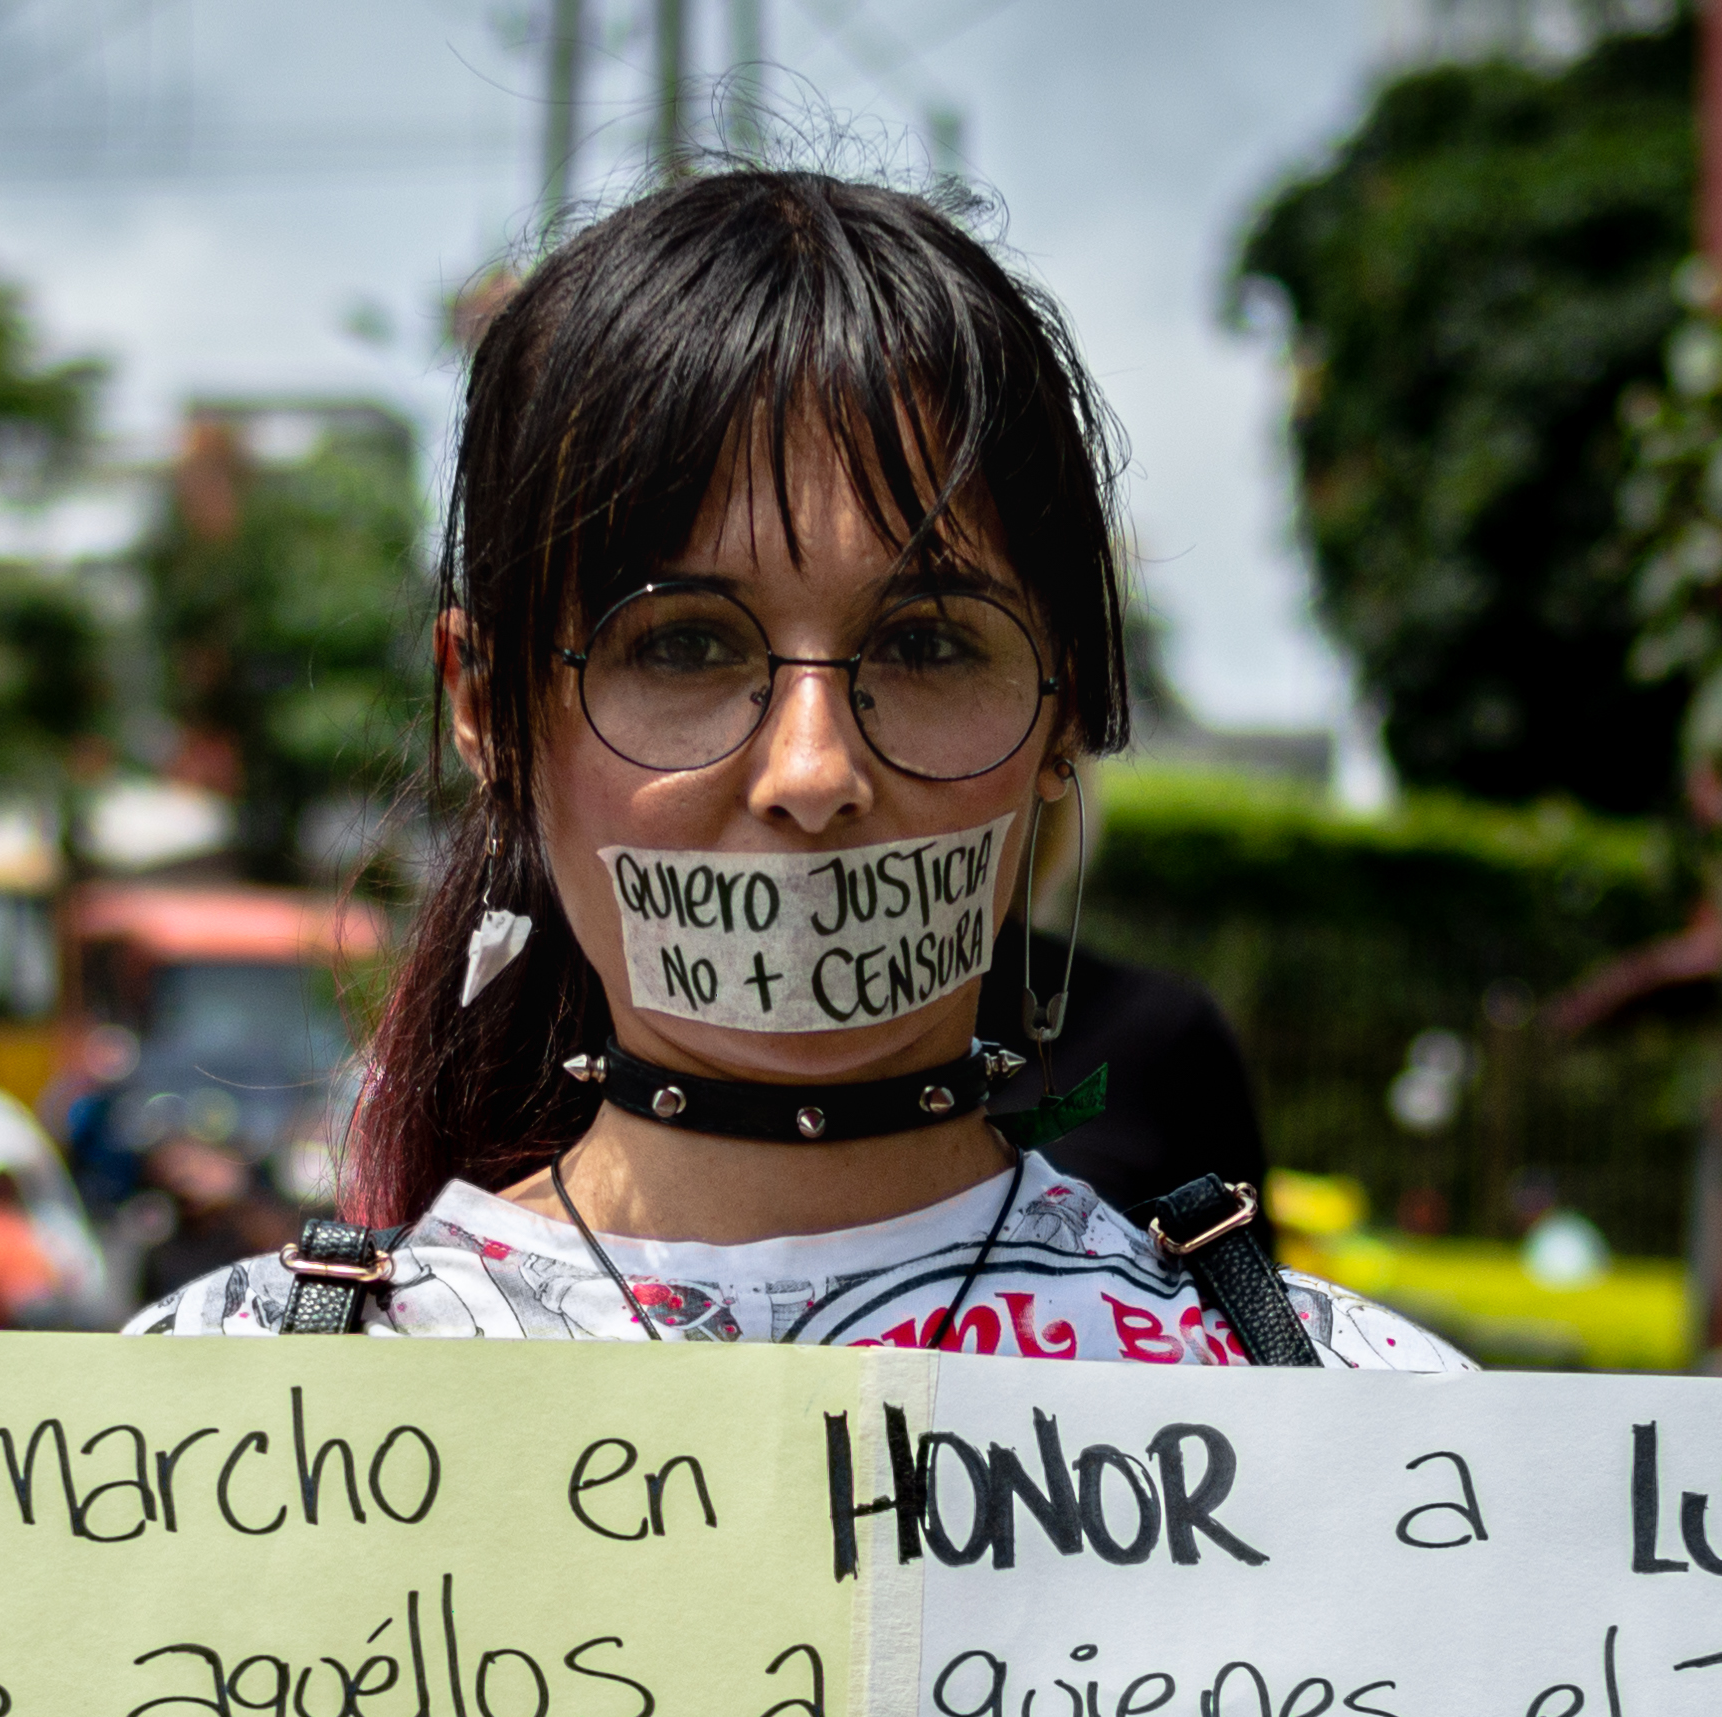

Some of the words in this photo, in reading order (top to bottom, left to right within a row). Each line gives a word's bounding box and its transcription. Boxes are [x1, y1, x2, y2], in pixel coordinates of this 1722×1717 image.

[808, 828, 994, 936] JUSTICIA
[744, 951, 784, 1013] +
[812, 906, 984, 1023] CENSURA
[568, 1438, 717, 1541] en
[824, 1402, 1270, 1583] HONOR
[1396, 1451, 1488, 1549] a
